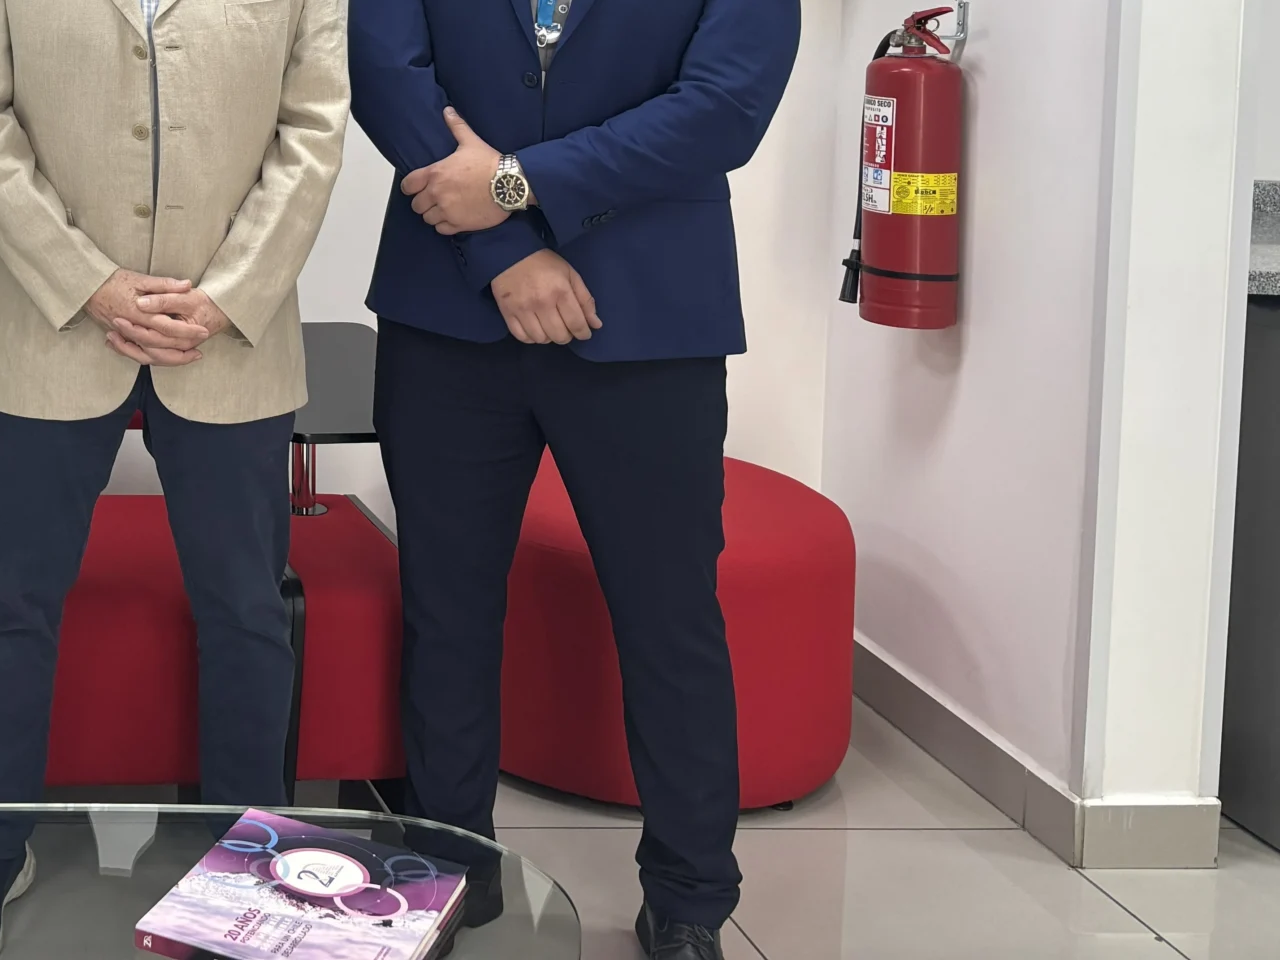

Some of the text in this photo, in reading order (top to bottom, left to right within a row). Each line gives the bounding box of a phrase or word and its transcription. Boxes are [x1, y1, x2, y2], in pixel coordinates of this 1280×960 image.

[877, 100, 892, 108] SECO
[224, 907, 262, 942] 20 AÑOS
